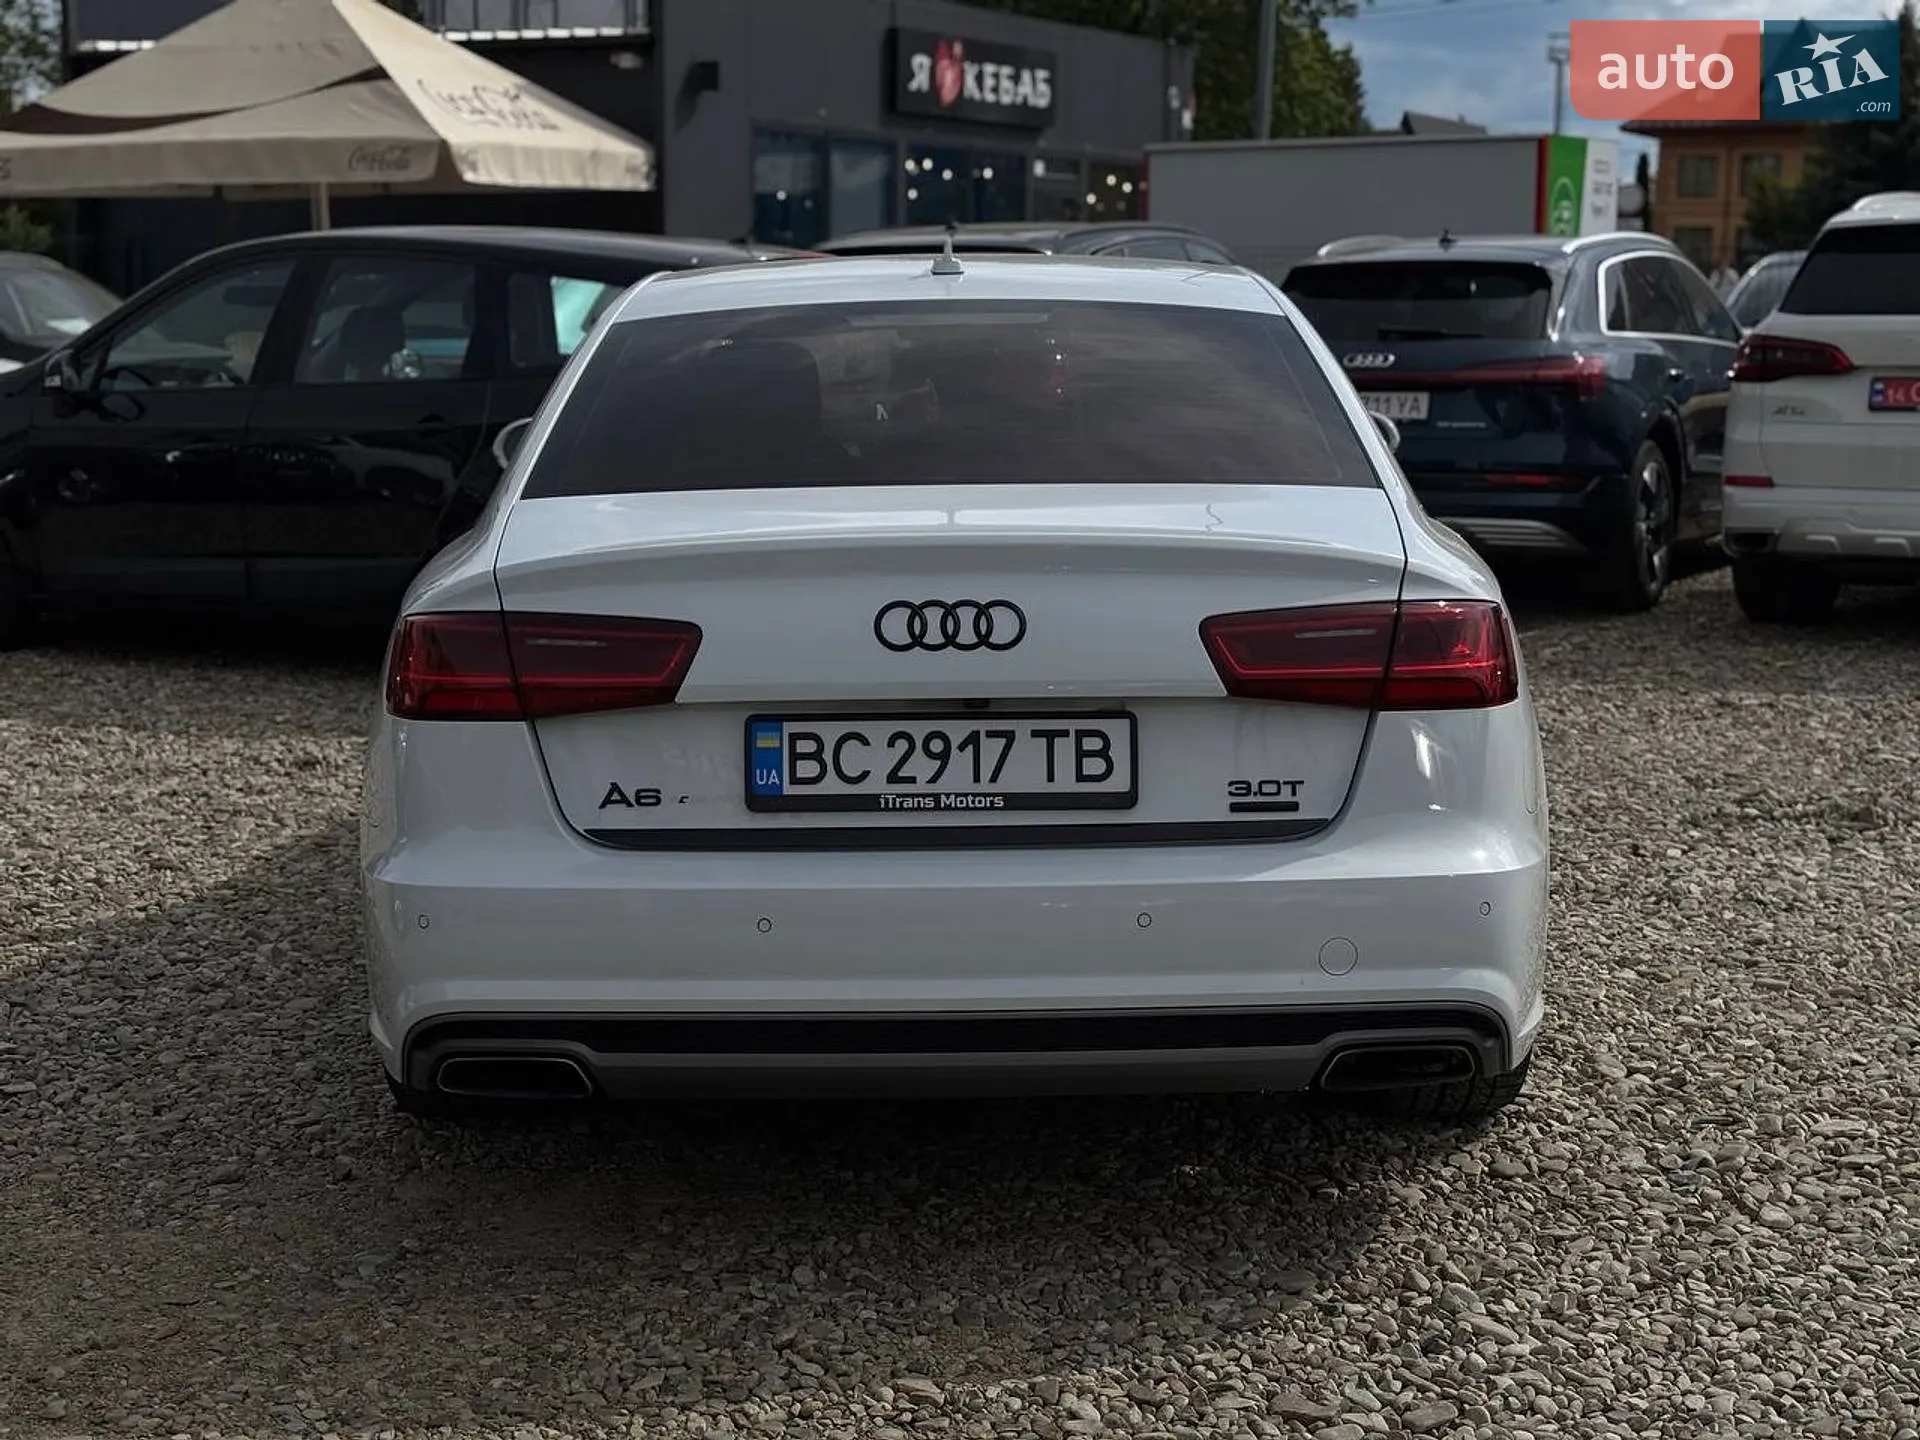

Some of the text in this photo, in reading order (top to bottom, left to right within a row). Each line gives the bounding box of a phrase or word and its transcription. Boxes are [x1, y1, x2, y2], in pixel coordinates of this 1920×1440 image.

[907, 53, 1052, 109] Я КЕБАБ
[788, 729, 1114, 785] BC 2917 TB
[756, 769, 779, 785] UA
[598, 782, 662, 809] A6
[1227, 780, 1304, 797] 3.0T
[879, 793, 1004, 809] iTrans Motors
